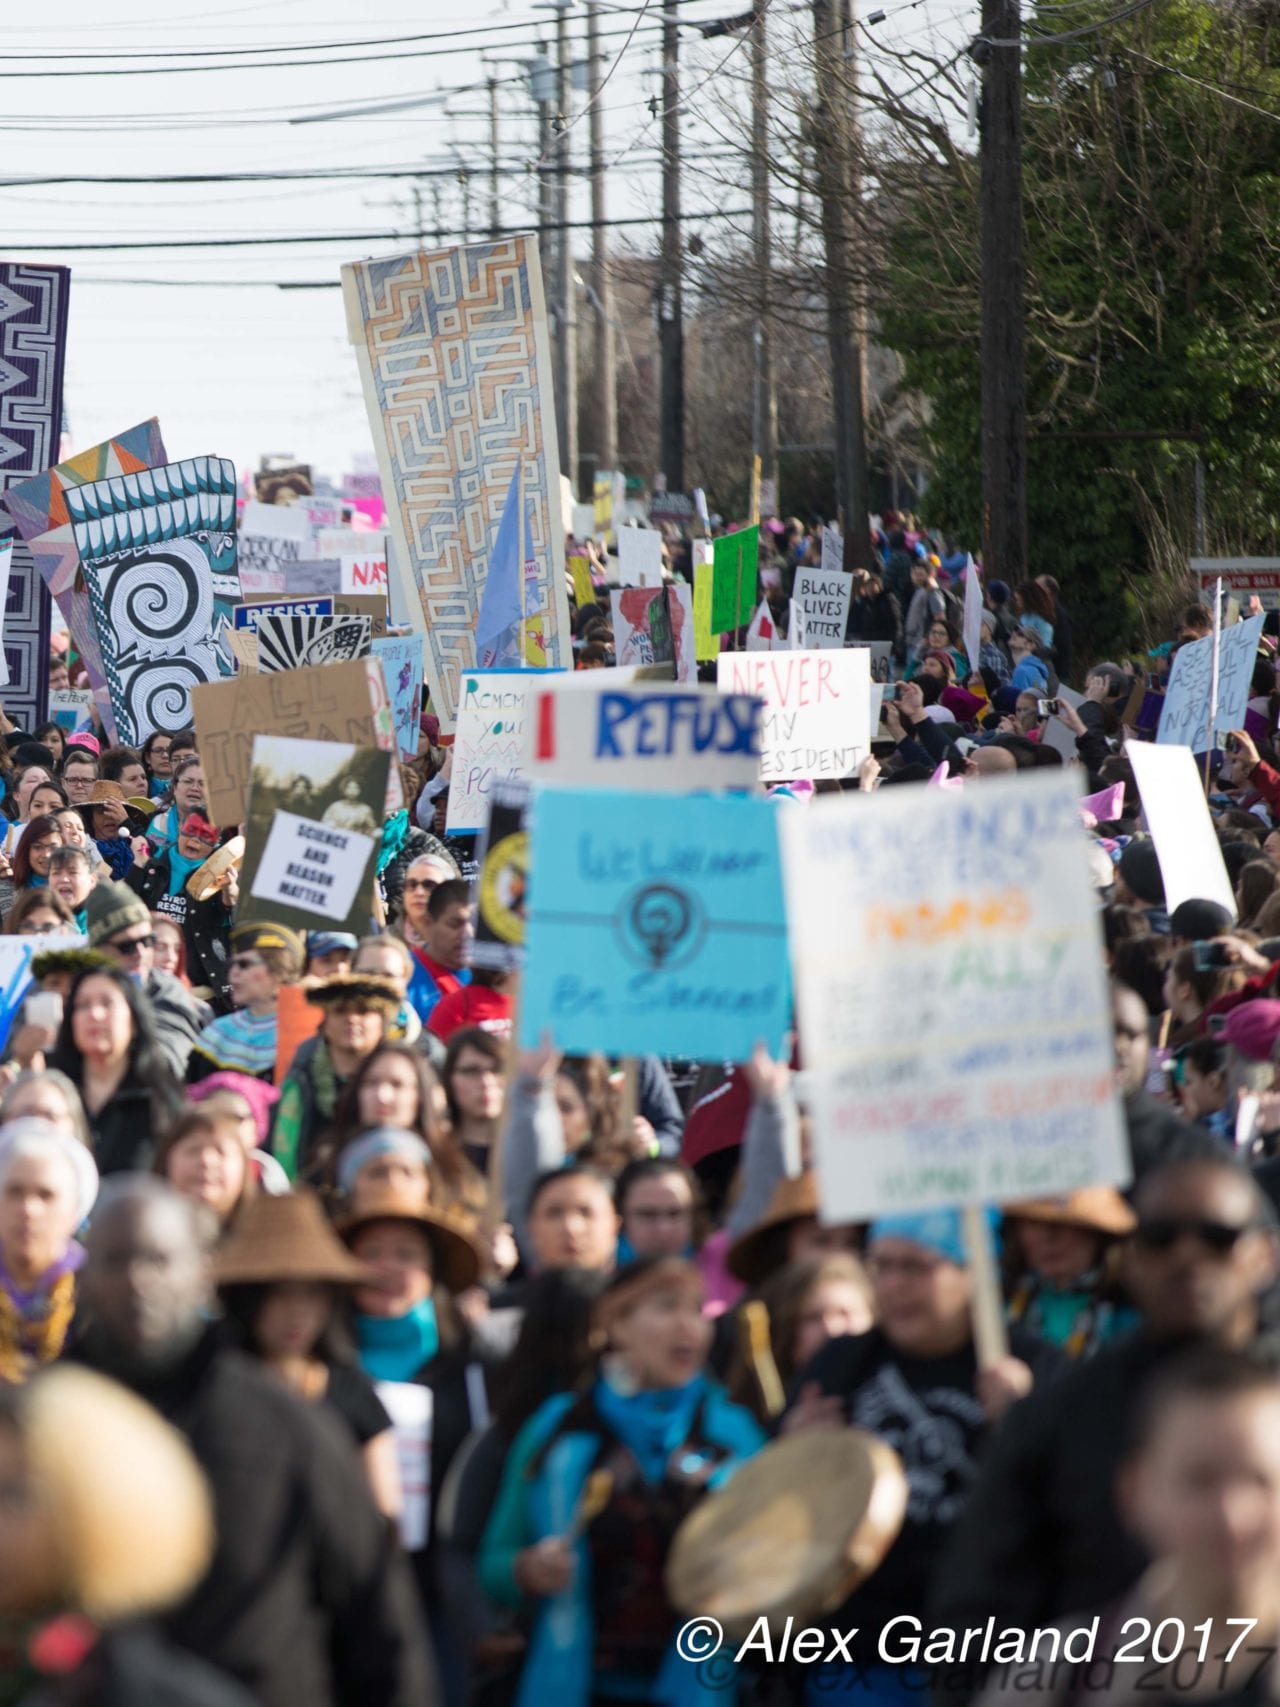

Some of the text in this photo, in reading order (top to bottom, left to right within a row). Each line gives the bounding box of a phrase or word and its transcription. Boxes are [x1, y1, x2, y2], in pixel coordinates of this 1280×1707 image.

[801, 579, 847, 597] BLACK
[803, 599, 842, 616] LIVES
[805, 620, 841, 638] ATTER
[733, 657, 840, 707] NEVER
[231, 675, 338, 728] ALL
[536, 691, 765, 761] I REFUSE
[760, 745, 863, 774] ESIDENT
[297, 823, 348, 849] SCIENCE
[304, 847, 329, 864] AND
[286, 863, 334, 887] REASON
